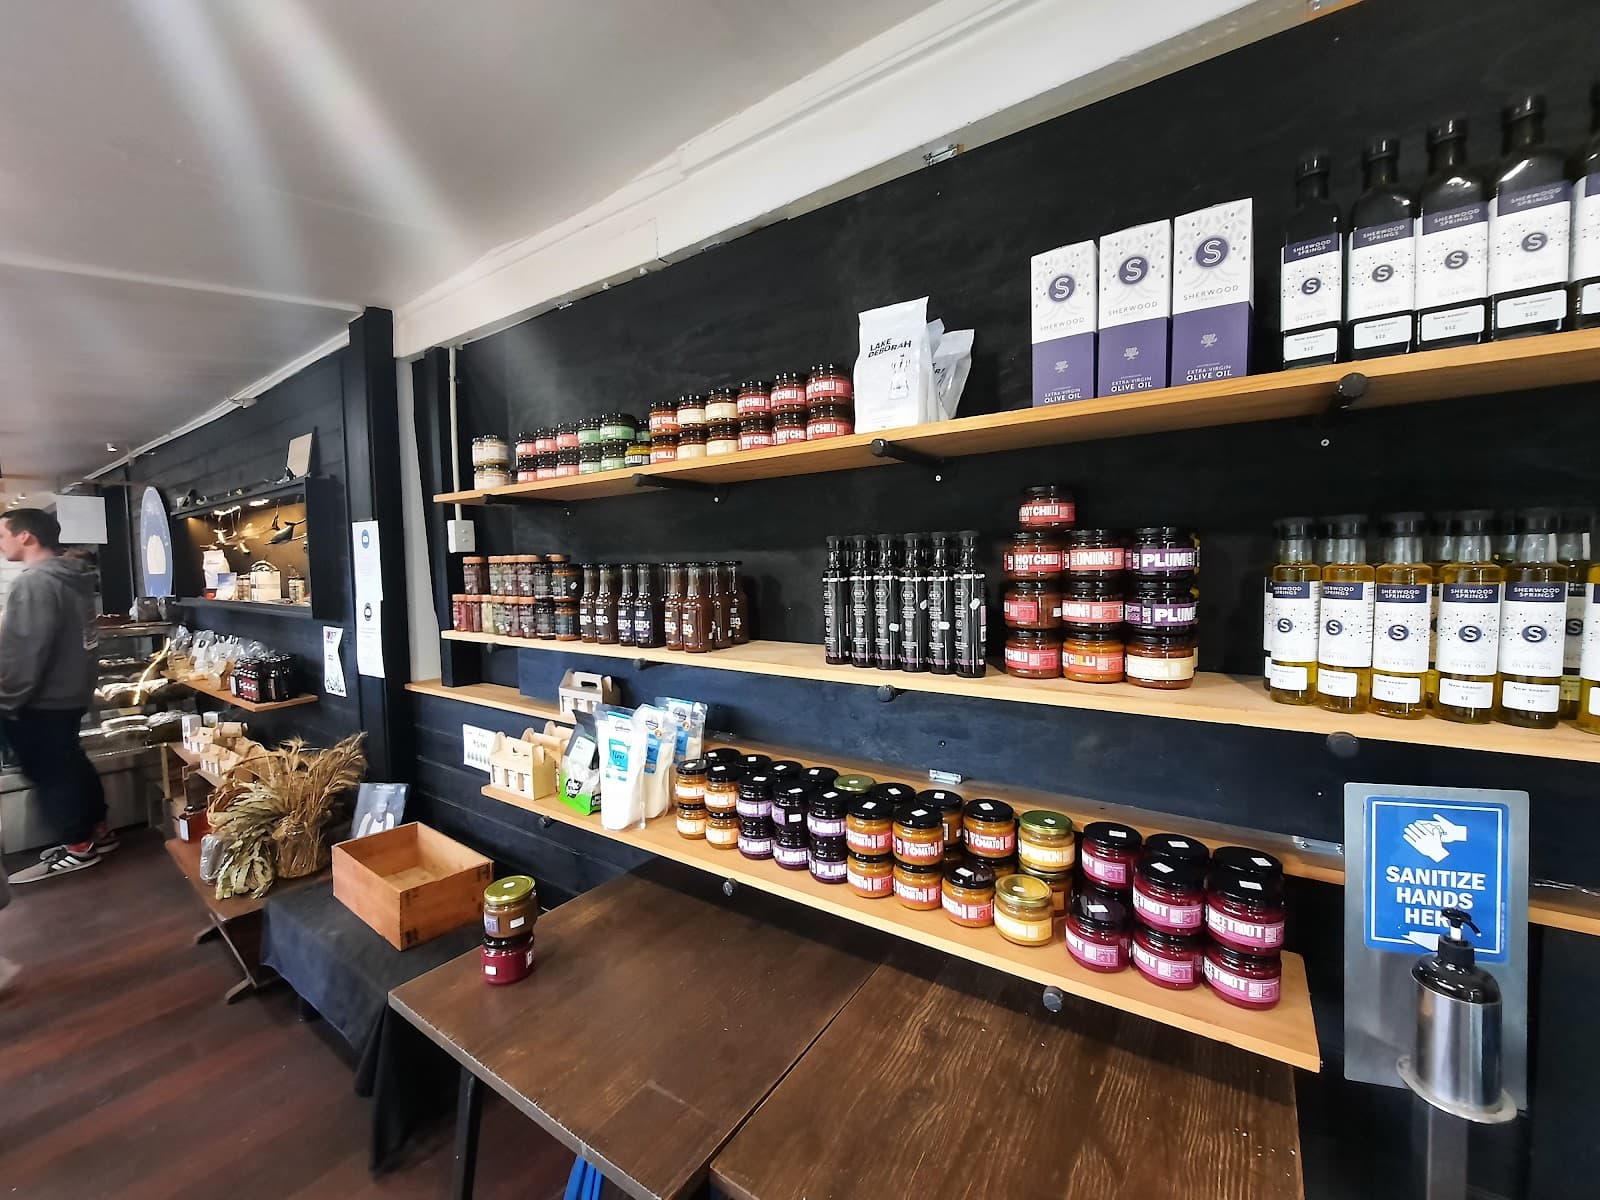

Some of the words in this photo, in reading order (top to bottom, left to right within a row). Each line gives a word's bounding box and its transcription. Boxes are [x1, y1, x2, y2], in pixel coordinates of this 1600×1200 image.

[1511, 187, 1562, 204] SHERWOOD
[1517, 194, 1555, 207] SPRINGS
[1434, 208, 1480, 224] SHERWOOD
[1440, 215, 1474, 227] SPRINGS
[1363, 224, 1406, 239] SHERWOOD
[1368, 231, 1399, 242] SPRINGS
[1293, 239, 1332, 253] SHERWOOD
[1526, 234, 1543, 250] S
[1203, 240, 1221, 264] S
[1297, 246, 1327, 256] SPRINGS
[1447, 252, 1466, 268] S
[1125, 258, 1142, 281] S
[1374, 266, 1391, 281] S
[1054, 277, 1070, 299] S
[1183, 285, 1239, 301] SHERWOOD
[1304, 279, 1318, 294] S
[1108, 300, 1158, 317] SHERWOOD
[1040, 317, 1085, 332] SHERWOOD
[868, 340, 912, 358] DEBORAH
[870, 337, 892, 351] LAKE
[1186, 372, 1213, 382] OLIVE
[1215, 369, 1232, 377] OIL
[1208, 365, 1232, 373] VIRGIN
[1110, 383, 1134, 393] OLIVE
[1137, 381, 1153, 389] OIL
[1044, 395, 1067, 404] OLIVE
[1068, 392, 1082, 400] OIL
[1142, 552, 1187, 568] PLUM
[1154, 607, 1193, 622] PLUM
[1328, 621, 1340, 634] S
[1392, 626, 1405, 639] S
[1463, 626, 1477, 641] S
[1527, 626, 1542, 641] S
[1385, 865, 1486, 891] SANITIZE
[1396, 886, 1474, 910] HANDS
[1404, 907, 1464, 931] HER
